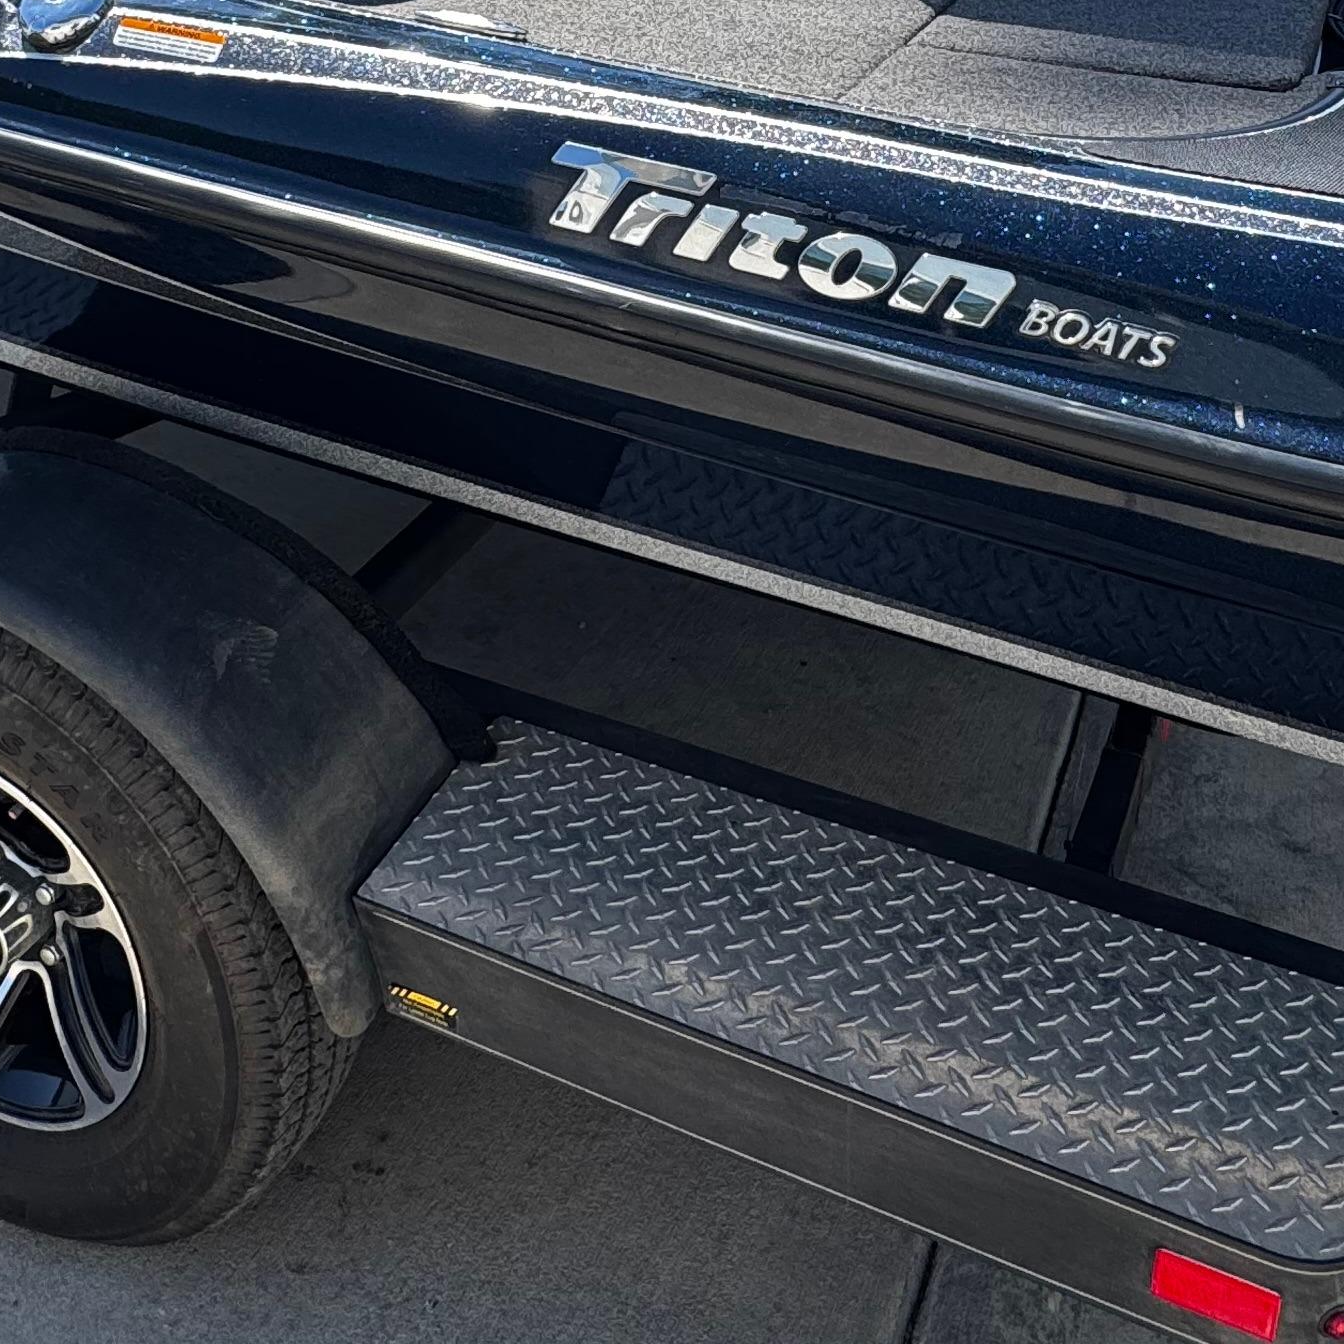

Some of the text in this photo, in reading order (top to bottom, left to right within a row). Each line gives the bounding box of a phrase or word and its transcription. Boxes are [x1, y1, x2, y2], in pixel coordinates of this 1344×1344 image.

[156, 24, 201, 40] WARNING
[549, 140, 1180, 369] Triton BOATS
